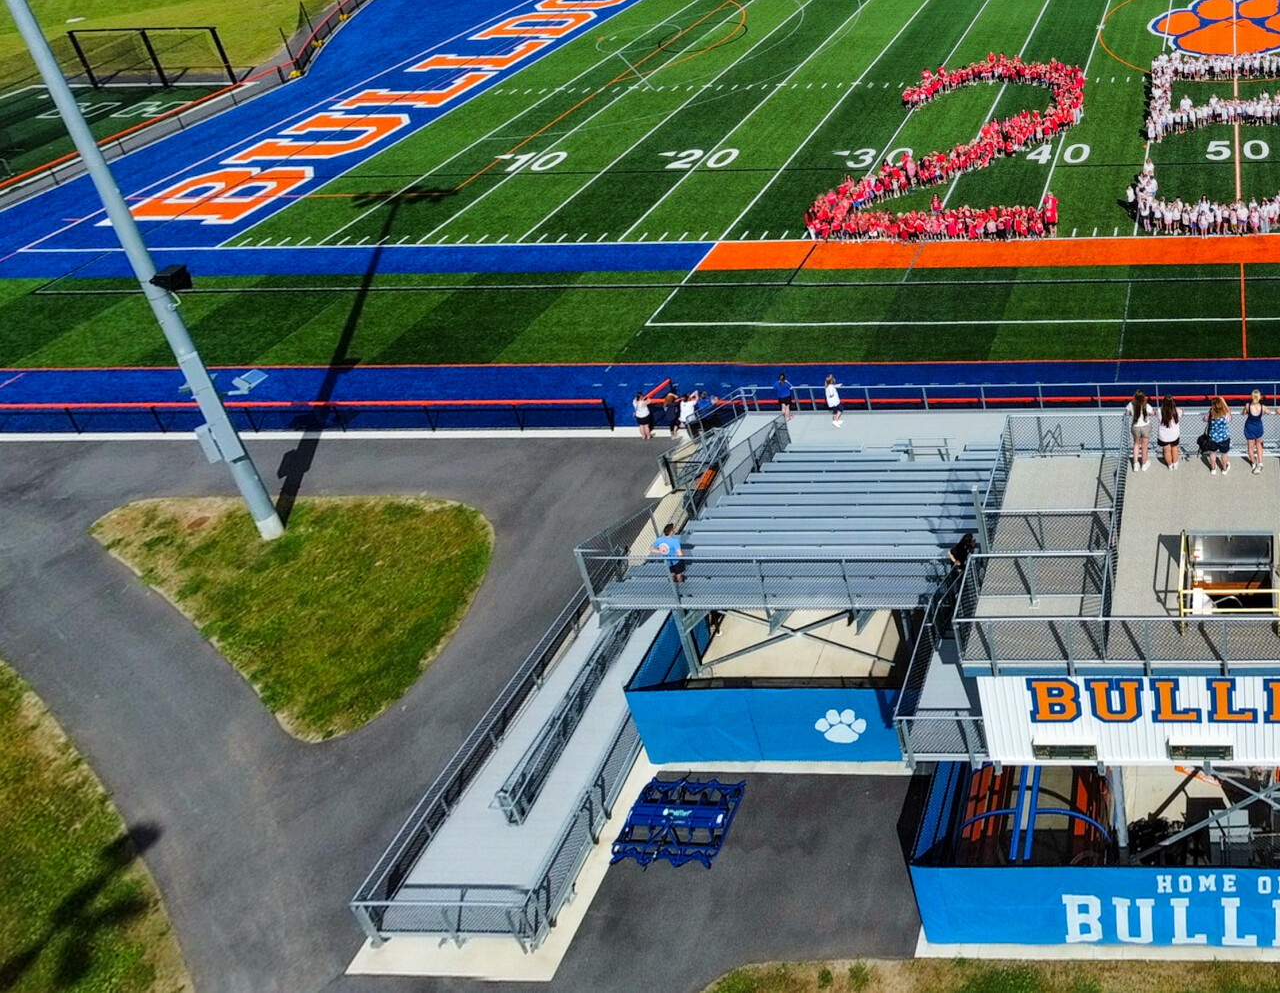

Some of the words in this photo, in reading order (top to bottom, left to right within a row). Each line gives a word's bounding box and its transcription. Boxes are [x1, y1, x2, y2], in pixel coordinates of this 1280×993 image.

[664, 148, 740, 169] 20
[1025, 143, 1091, 165] 40
[1205, 140, 1270, 161] 50
[504, 151, 568, 172] 10
[1156, 874, 1238, 894] HOME
